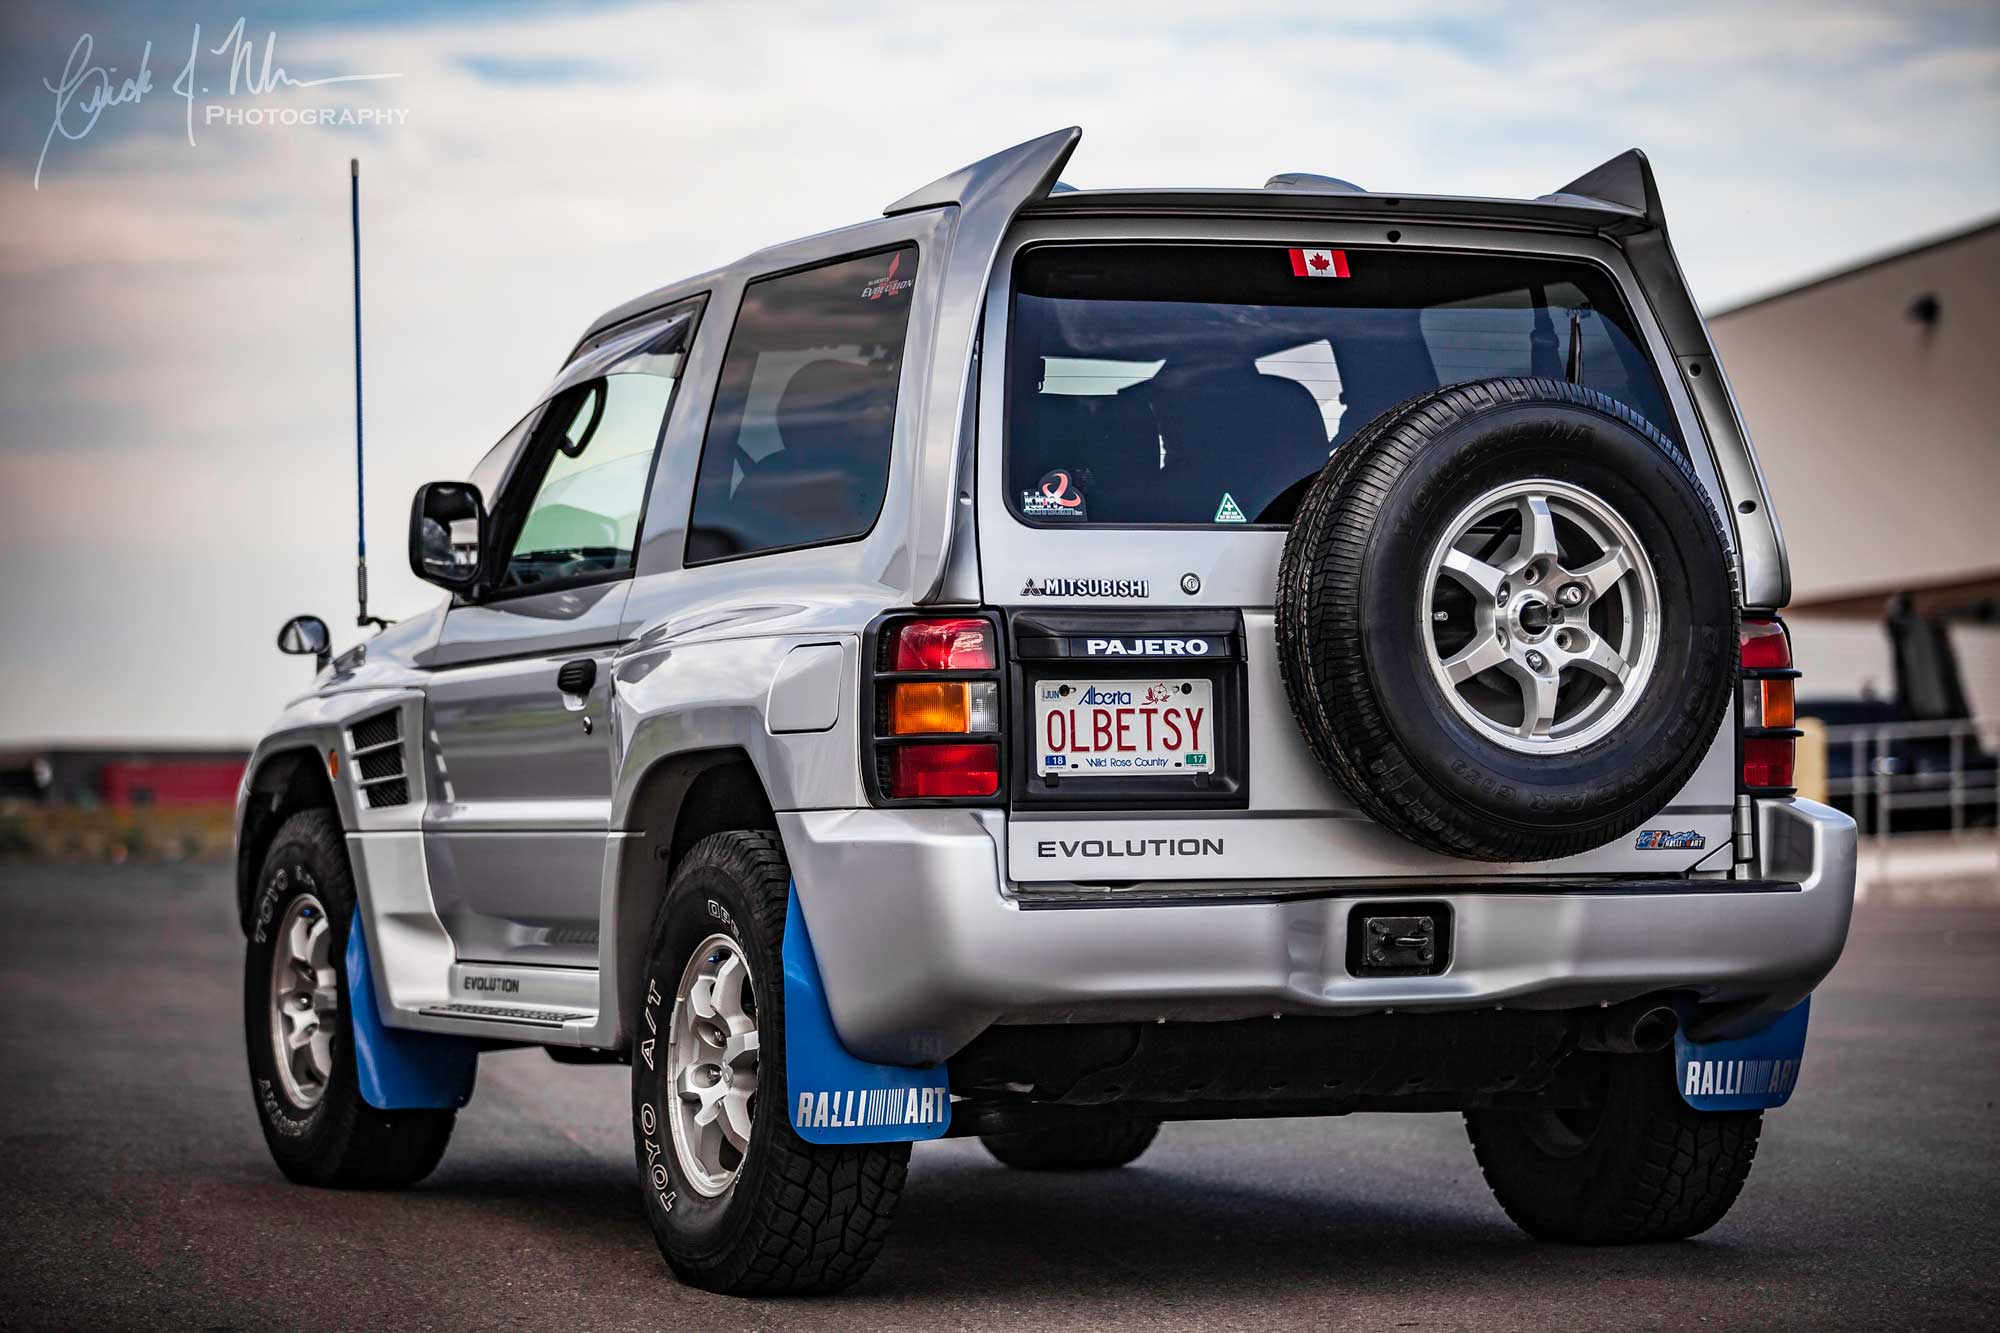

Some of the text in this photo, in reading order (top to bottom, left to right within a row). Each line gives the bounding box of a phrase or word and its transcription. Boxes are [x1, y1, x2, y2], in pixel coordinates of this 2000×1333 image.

[1045, 578, 1149, 597] MITSUBISHI
[1086, 639, 1209, 655] PAJERO
[1078, 685, 1132, 706] Alberta
[1046, 707, 1204, 752] OLBETSY
[1052, 757, 1064, 766] 18
[1086, 758, 1169, 768] Wild Rose Country
[1192, 755, 1204, 764] 17
[1038, 838, 1224, 858] EVOLUTION
[464, 976, 519, 993] EVOLUTION
[641, 978, 677, 1212] TOYO A/T
